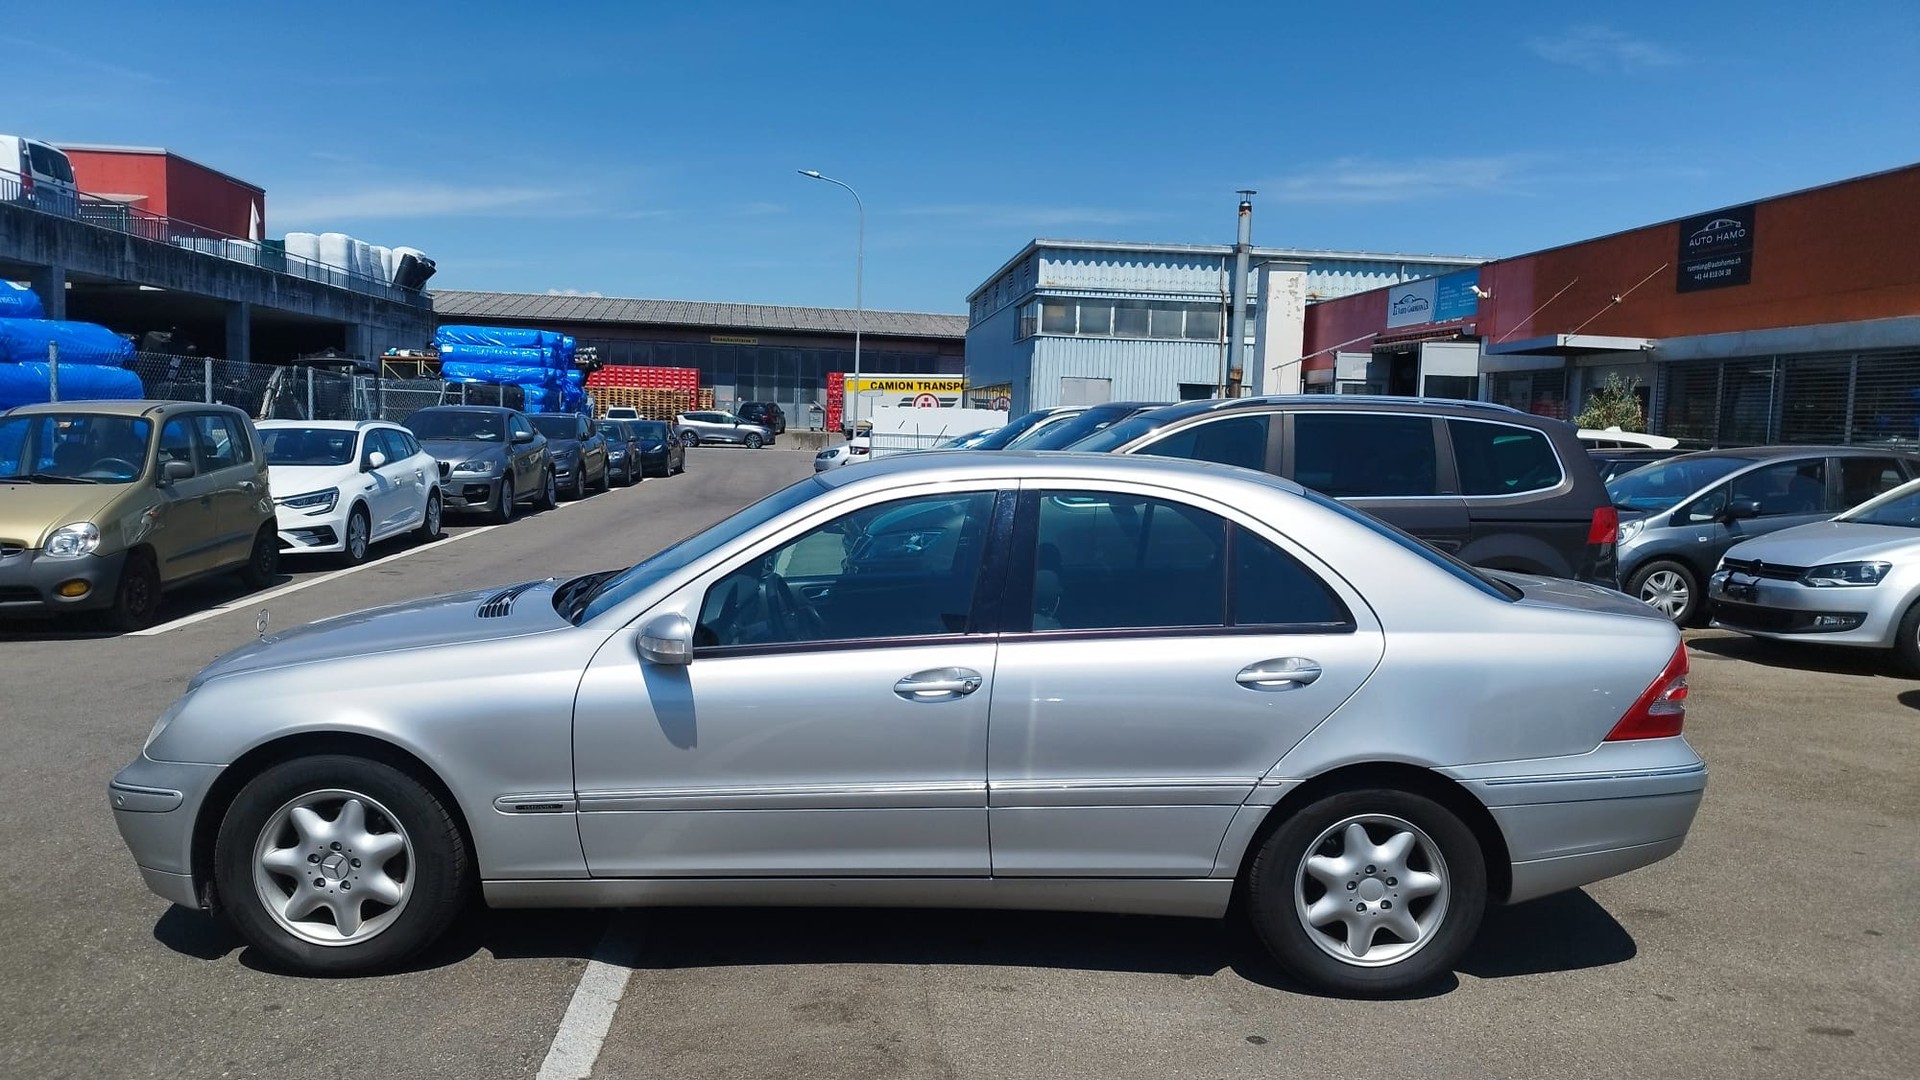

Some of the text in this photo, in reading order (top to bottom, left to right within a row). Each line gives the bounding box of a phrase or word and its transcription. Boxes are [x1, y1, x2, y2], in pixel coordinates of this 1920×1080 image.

[1689, 228, 1746, 247] AUTO HAMO
[870, 381, 913, 391] CAMION
